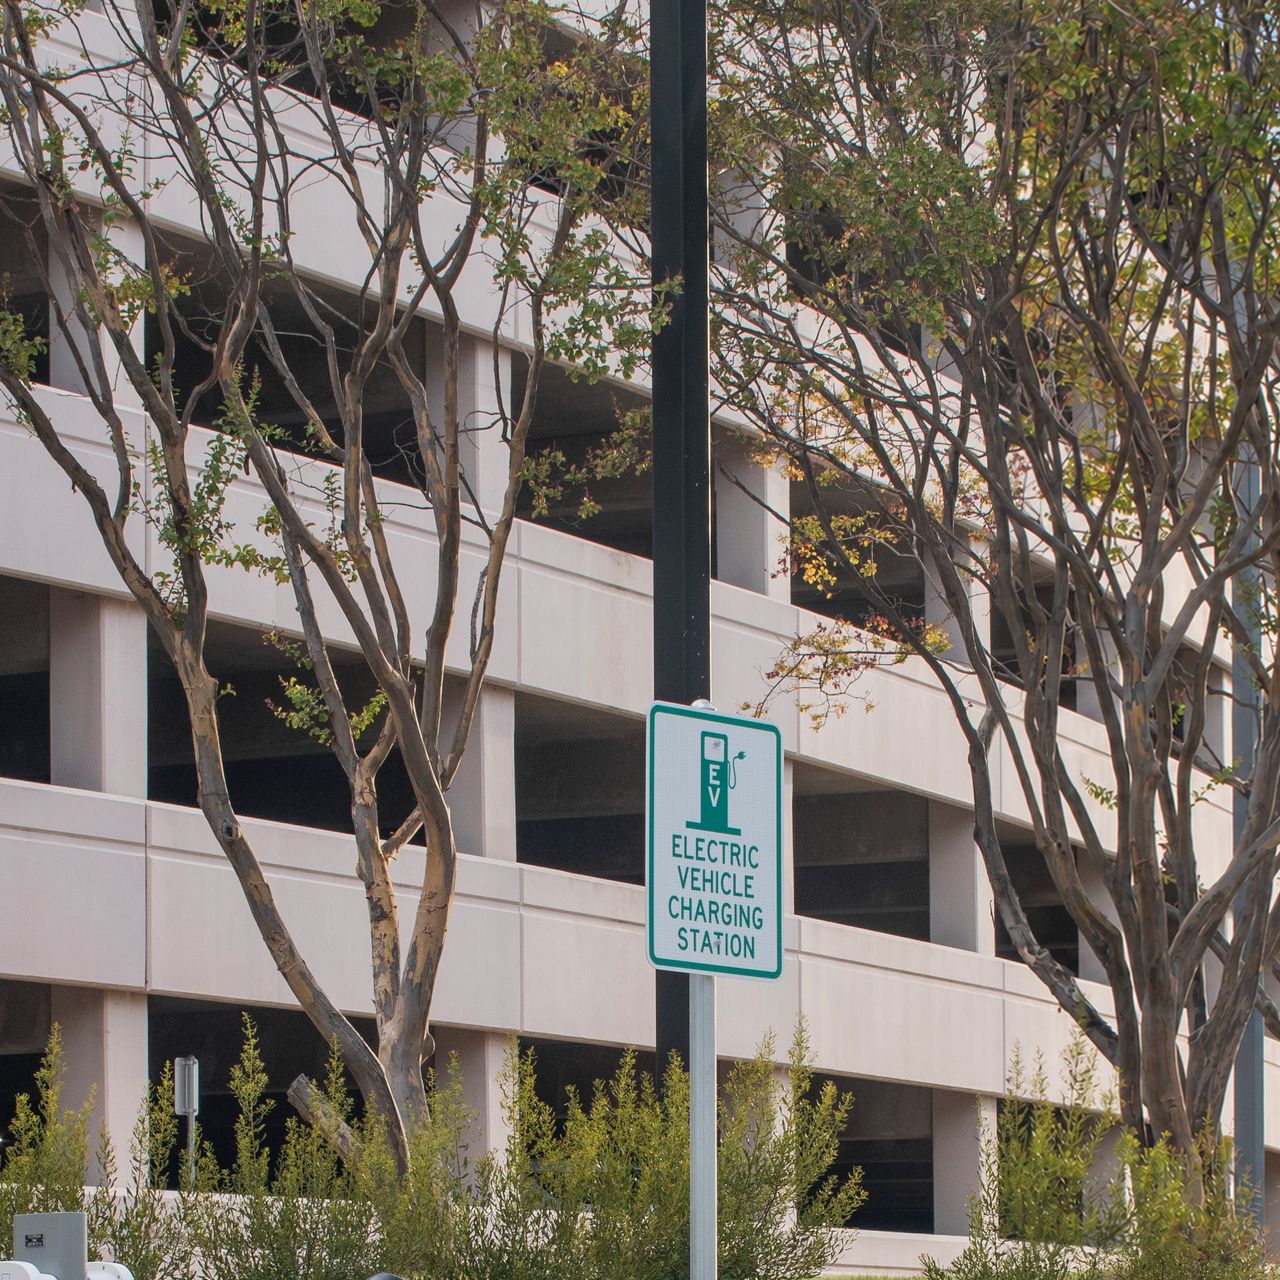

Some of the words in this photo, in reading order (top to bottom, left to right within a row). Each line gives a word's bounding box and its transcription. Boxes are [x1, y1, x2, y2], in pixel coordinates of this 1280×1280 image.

[708, 764, 720, 808] EV
[672, 834, 759, 869] ELECTRIC
[677, 865, 755, 899] VEHICLE
[668, 895, 763, 930] CHARGING
[677, 927, 755, 960] STATION
